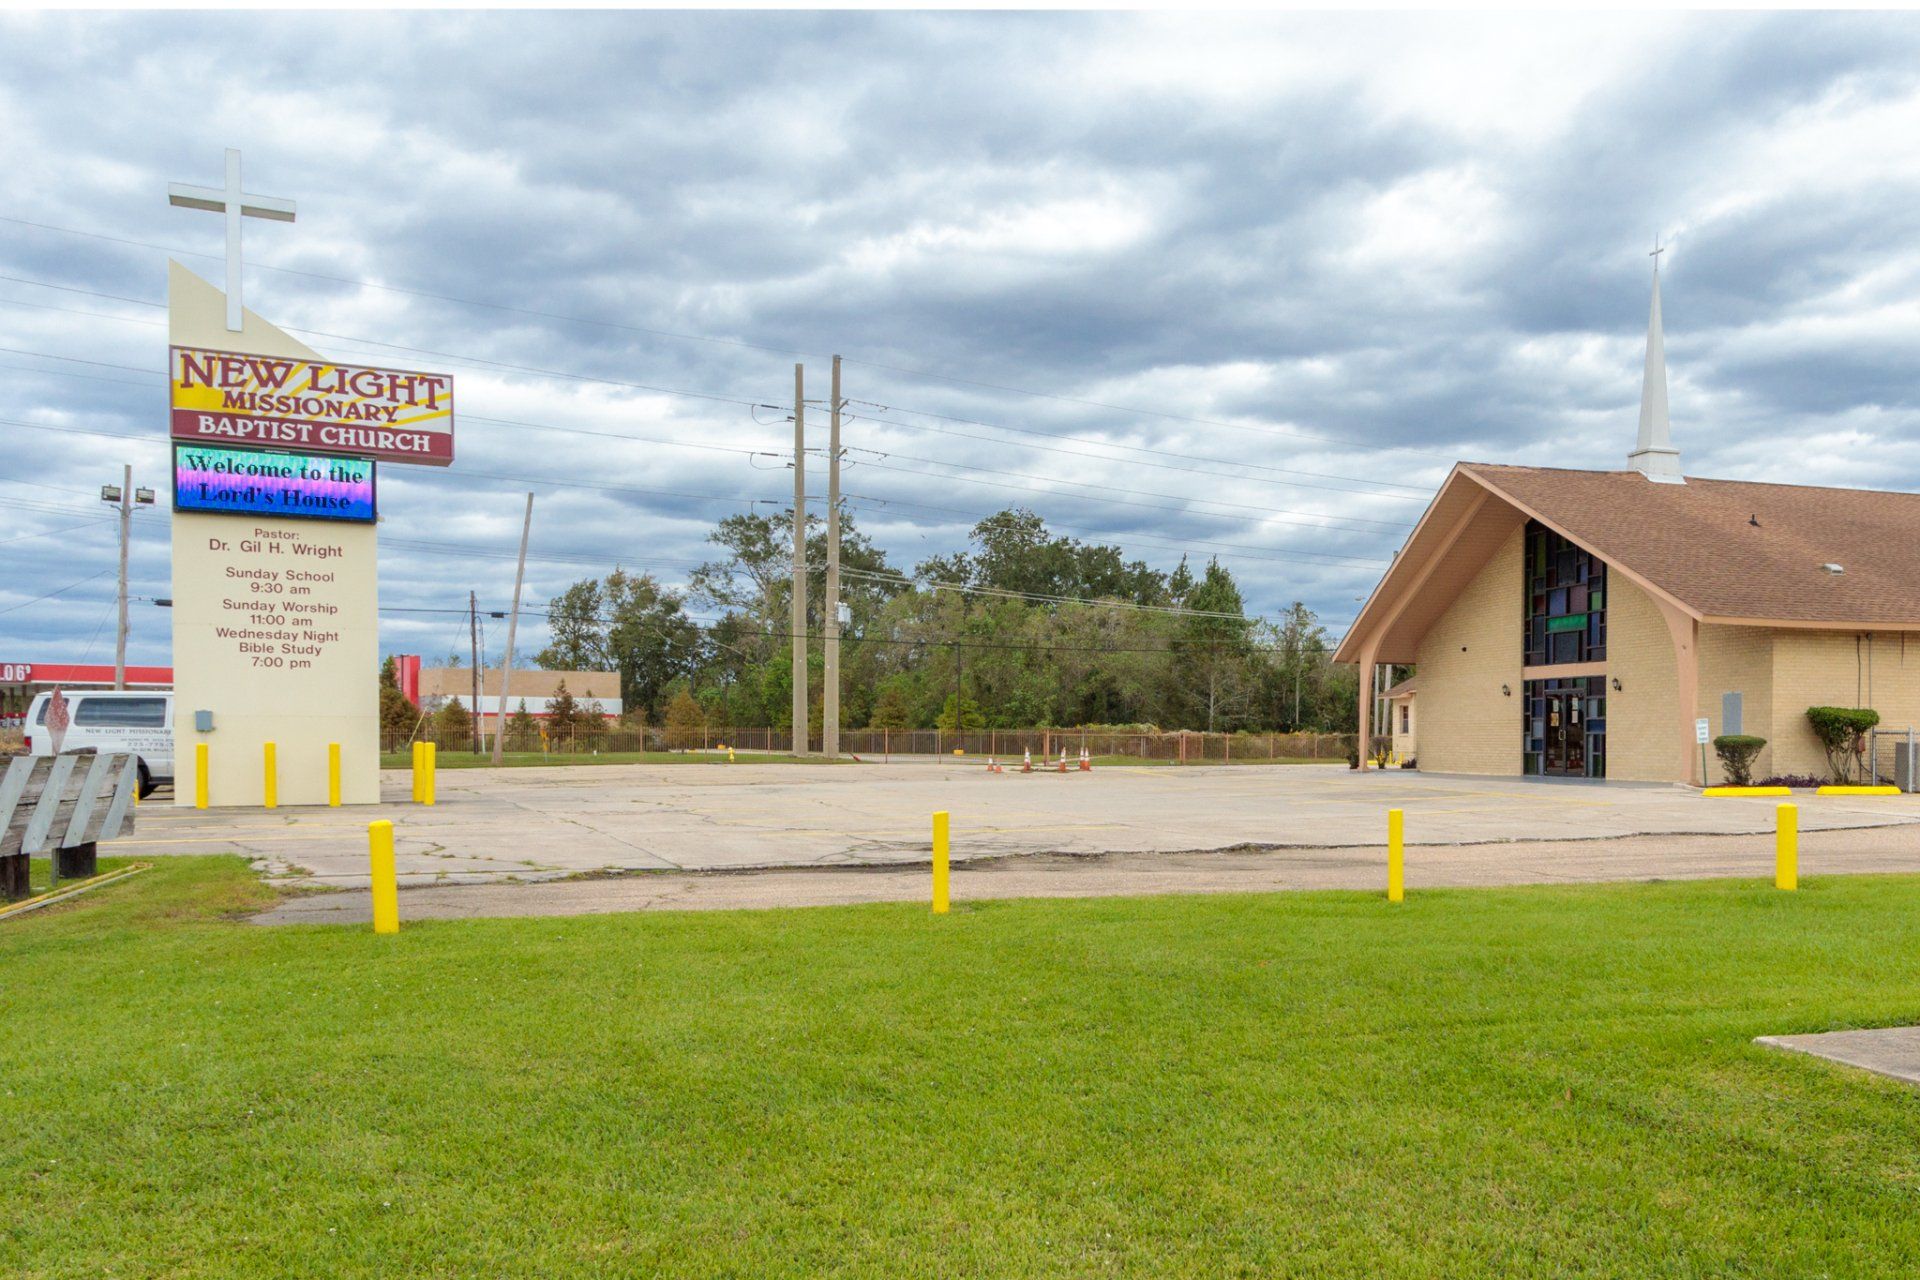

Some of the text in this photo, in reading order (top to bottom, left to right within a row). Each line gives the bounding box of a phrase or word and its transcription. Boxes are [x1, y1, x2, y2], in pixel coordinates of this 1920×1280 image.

[179, 353, 445, 411] NEW LIGHT
[221, 390, 399, 423] MISSIONARY
[198, 415, 431, 453] BAPTIST CHURCH
[185, 454, 364, 485] Welcome to the
[199, 482, 351, 510] Lord's House
[254, 528, 300, 540] Pastor:
[209, 538, 343, 559] Dr. Gil H. Wright
[226, 566, 335, 583] Sunday School
[250, 581, 311, 595] 9:30 am
[222, 598, 338, 616] Sunday Worship
[249, 613, 313, 627] 11:00 am
[216, 626, 340, 643] Wednesday Night
[239, 641, 323, 657] Bible Study
[251, 655, 312, 670] 7:00 pm
